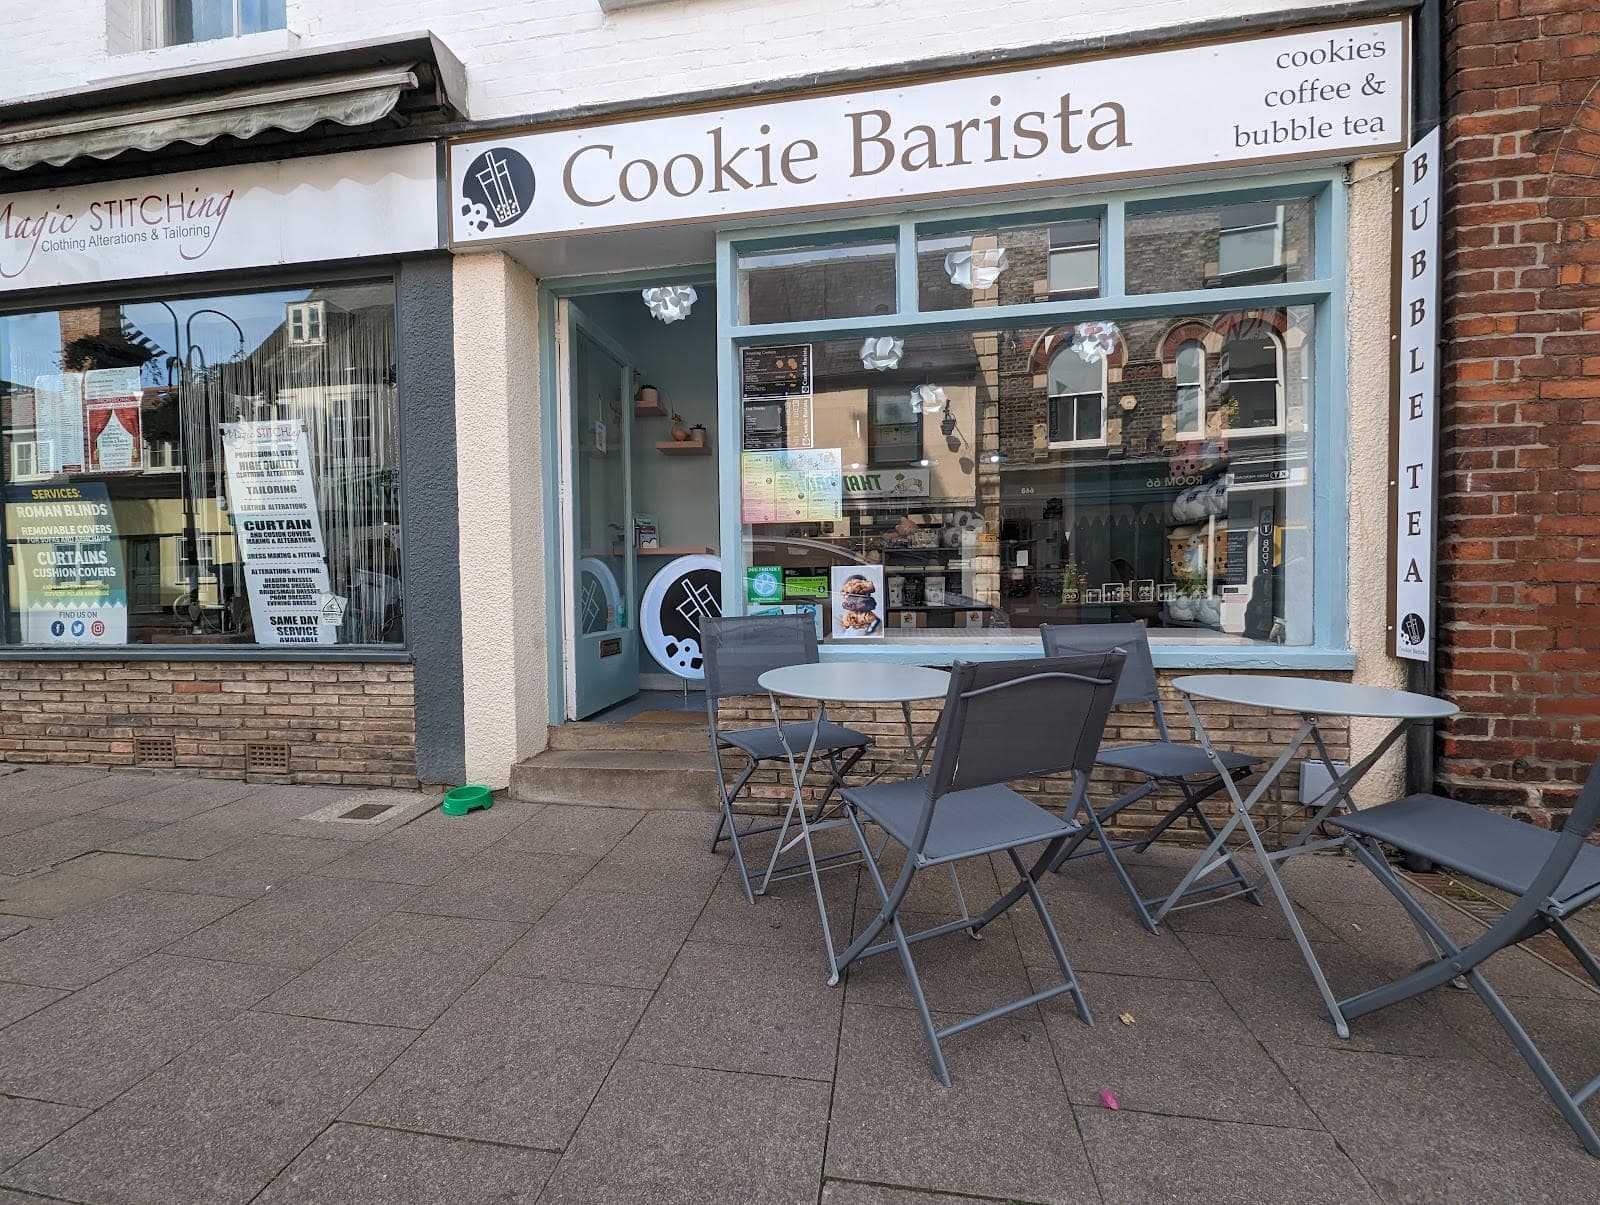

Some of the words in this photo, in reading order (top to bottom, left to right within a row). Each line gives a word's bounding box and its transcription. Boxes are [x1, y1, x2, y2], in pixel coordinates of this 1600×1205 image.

[1276, 38, 1386, 69] cookies
[1264, 78, 1350, 107] coffee
[1361, 72, 1386, 96] &
[1234, 116, 1333, 148] bubble
[1342, 115, 1385, 136] tea
[562, 124, 819, 207] Cookie
[844, 92, 1133, 177] Barista
[90, 187, 234, 260] STITCHing
[41, 239, 86, 252] Clothing
[88, 231, 147, 248] Alterations
[151, 229, 159, 240] &
[163, 224, 210, 239] Tailoring
[1409, 152, 1430, 421] BUBBLE
[239, 461, 261, 470] HIGH
[264, 460, 299, 470] QUALITY
[31, 487, 82, 500] SERVICES:
[246, 485, 297, 494] TAILORING
[16, 505, 62, 518] ROMAN
[63, 504, 108, 517] BLINDS
[21, 526, 76, 536] REMOVABLE
[76, 524, 112, 534] COVERS
[244, 519, 312, 531] CURTAIN
[1404, 463, 1424, 583] TEA
[36, 550, 108, 566] CURTAINS
[33, 568, 76, 578] CUSHION
[78, 567, 116, 577] COVERS
[270, 616, 298, 626] SAME
[300, 616, 318, 625] DAY
[277, 627, 318, 636] SERVICE
